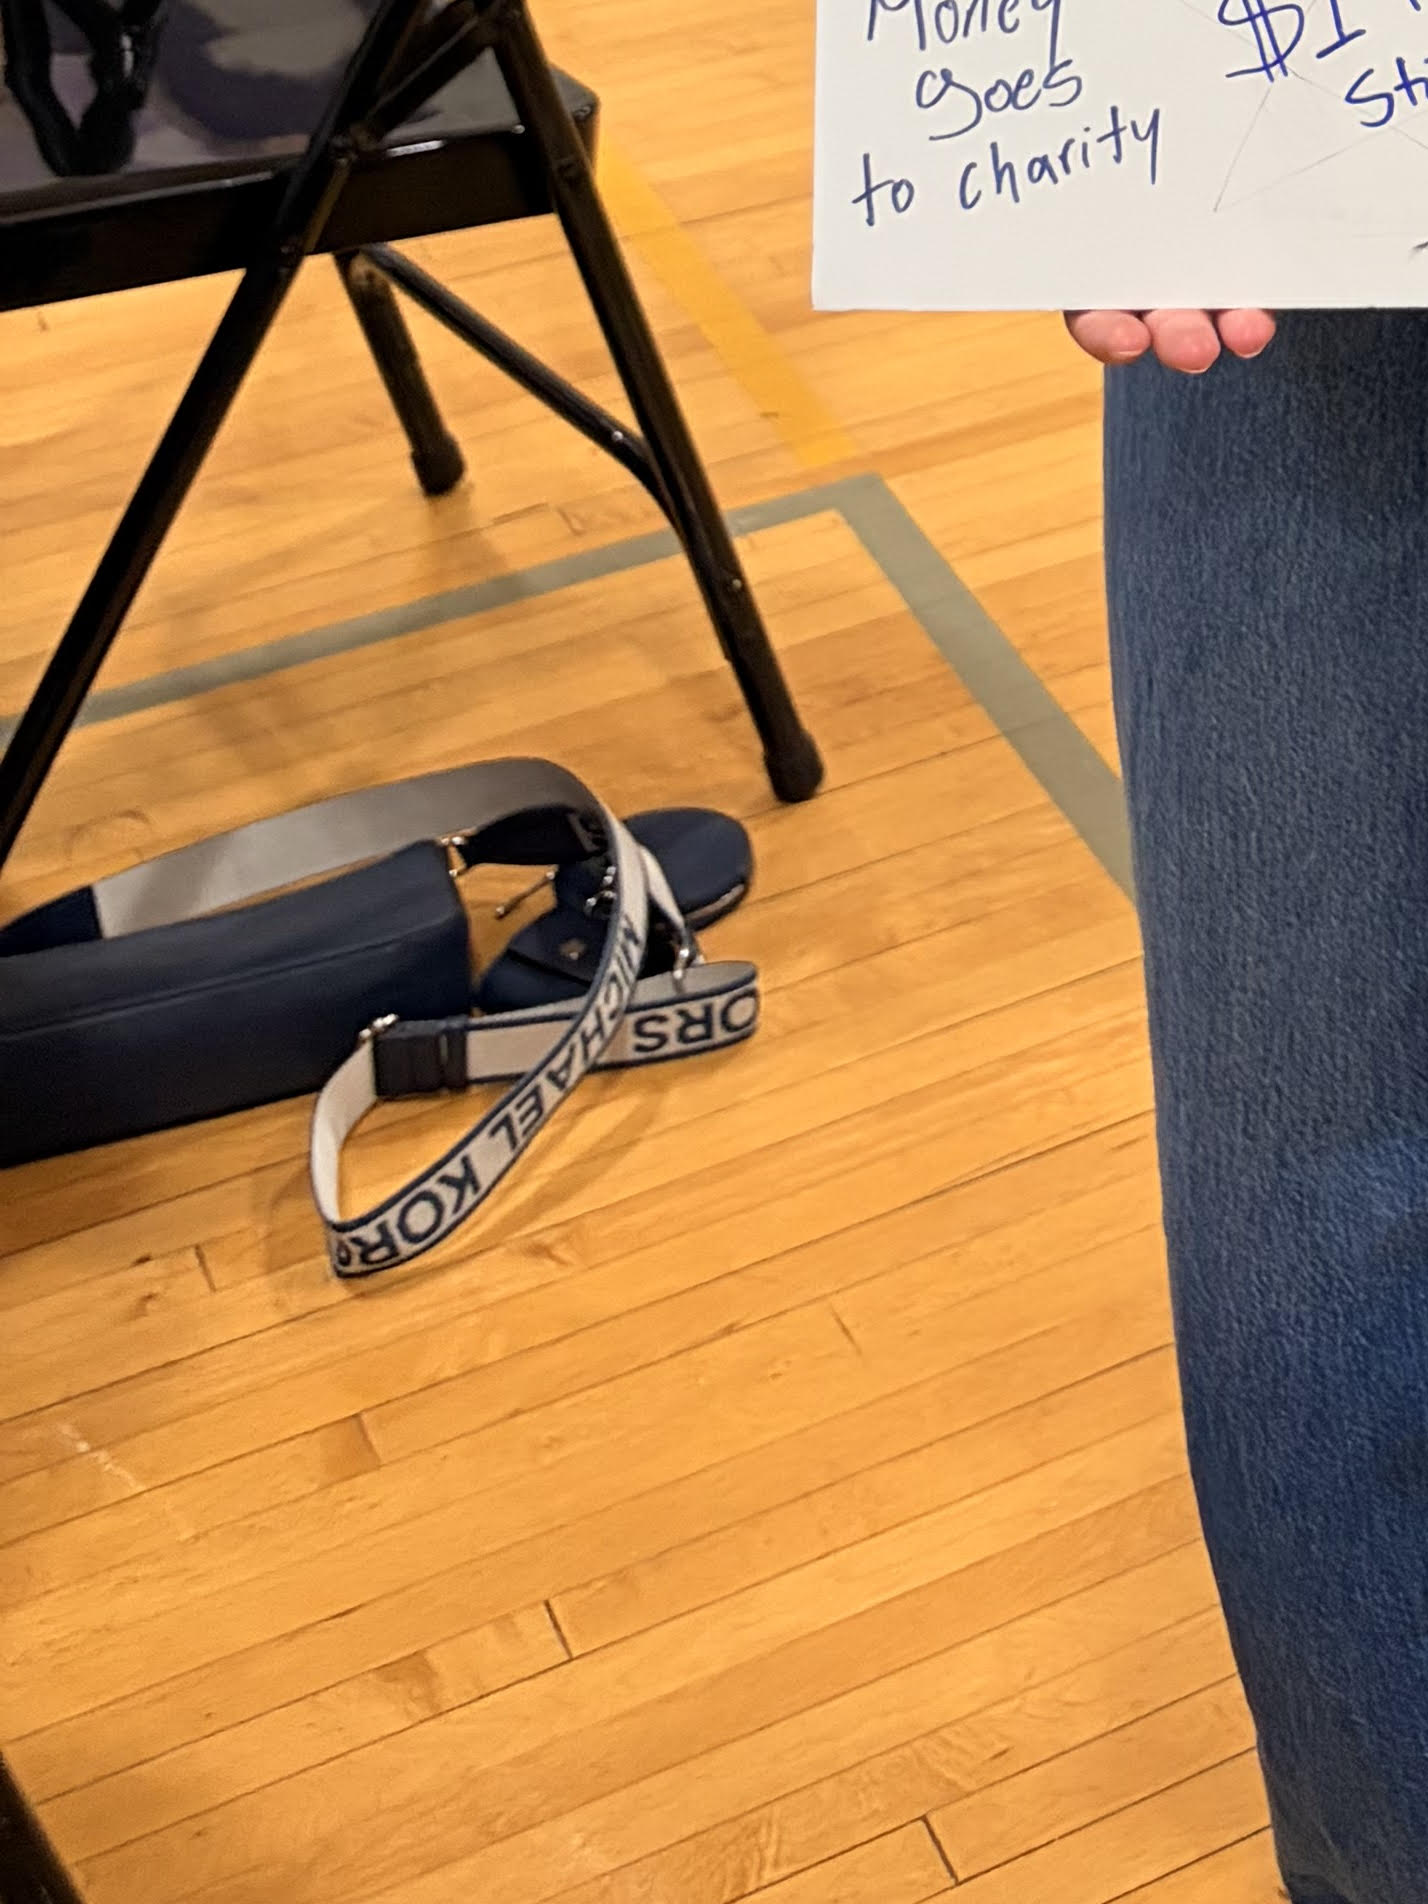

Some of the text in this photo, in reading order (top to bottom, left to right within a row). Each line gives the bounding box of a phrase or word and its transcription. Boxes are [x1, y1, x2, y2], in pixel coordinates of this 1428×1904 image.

[914, 56, 1083, 141] goes
[852, 105, 1163, 228] to charity
[633, 988, 757, 1054] ORS
